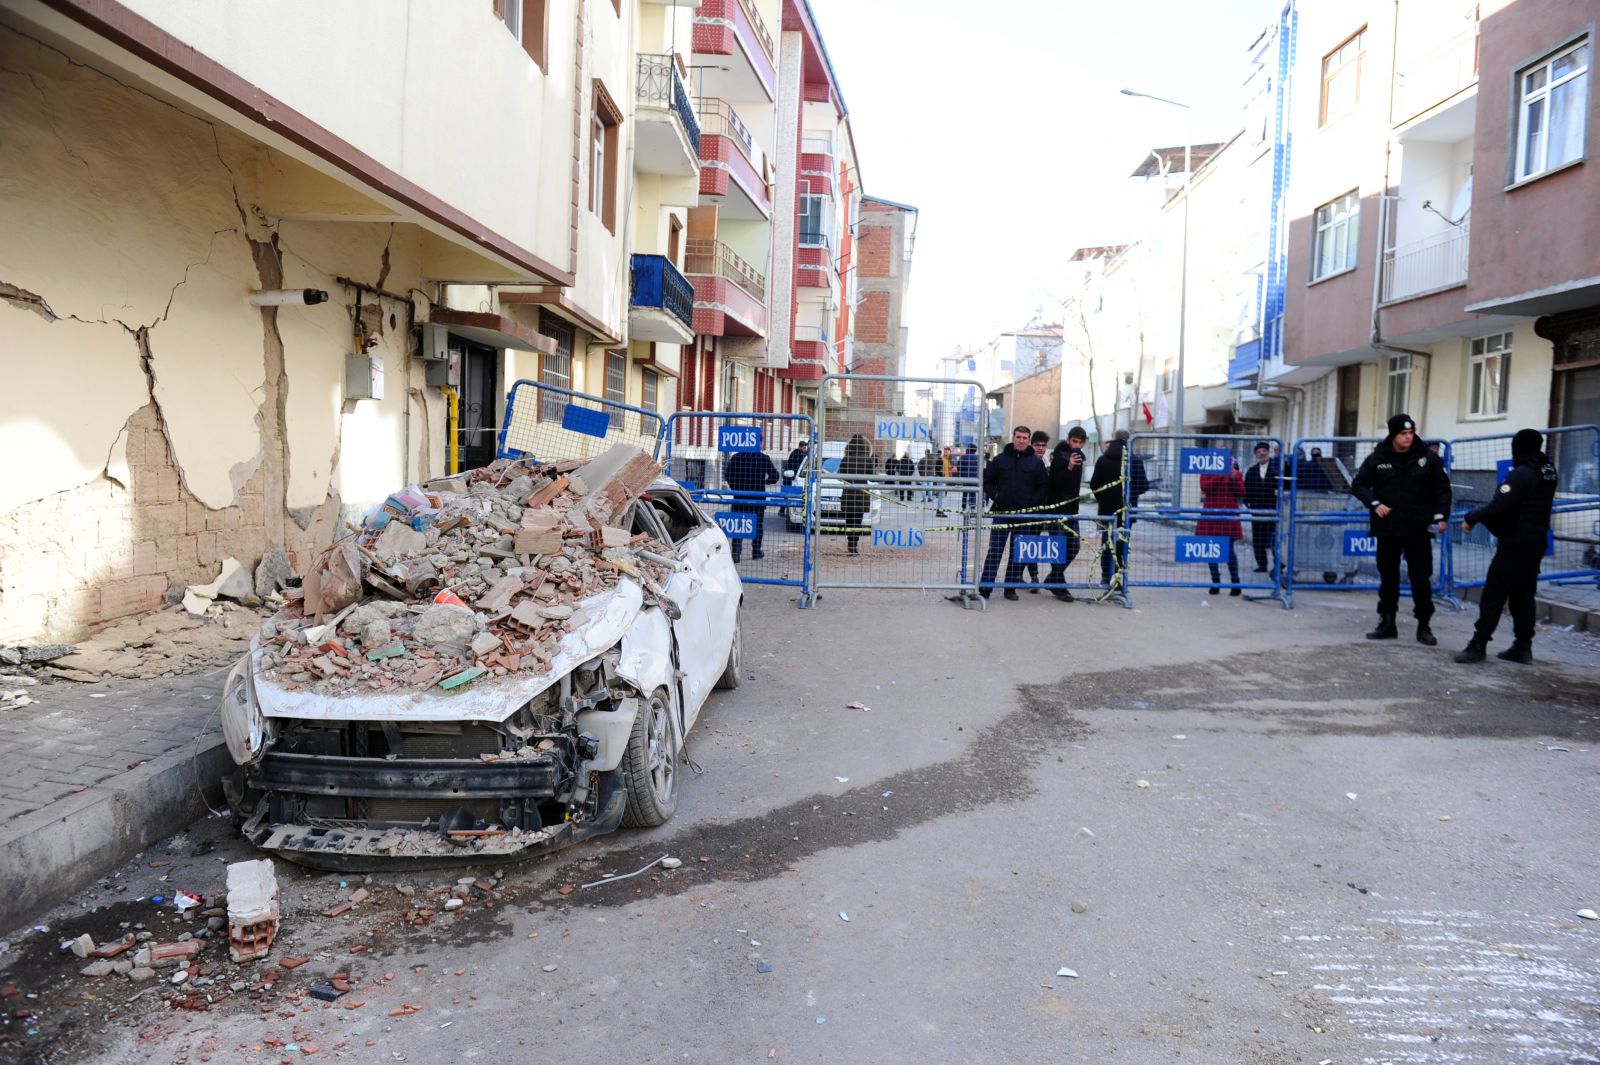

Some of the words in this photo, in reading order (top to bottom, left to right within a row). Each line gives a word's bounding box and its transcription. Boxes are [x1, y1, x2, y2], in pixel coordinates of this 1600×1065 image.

[722, 428, 757, 447] POLİS
[877, 420, 928, 439] POLİS
[1188, 452, 1225, 471] POLİS
[719, 515, 753, 534] POLİS
[873, 527, 924, 547] POLİS
[1019, 538, 1059, 560] POLİS
[1184, 540, 1221, 559] POLİS
